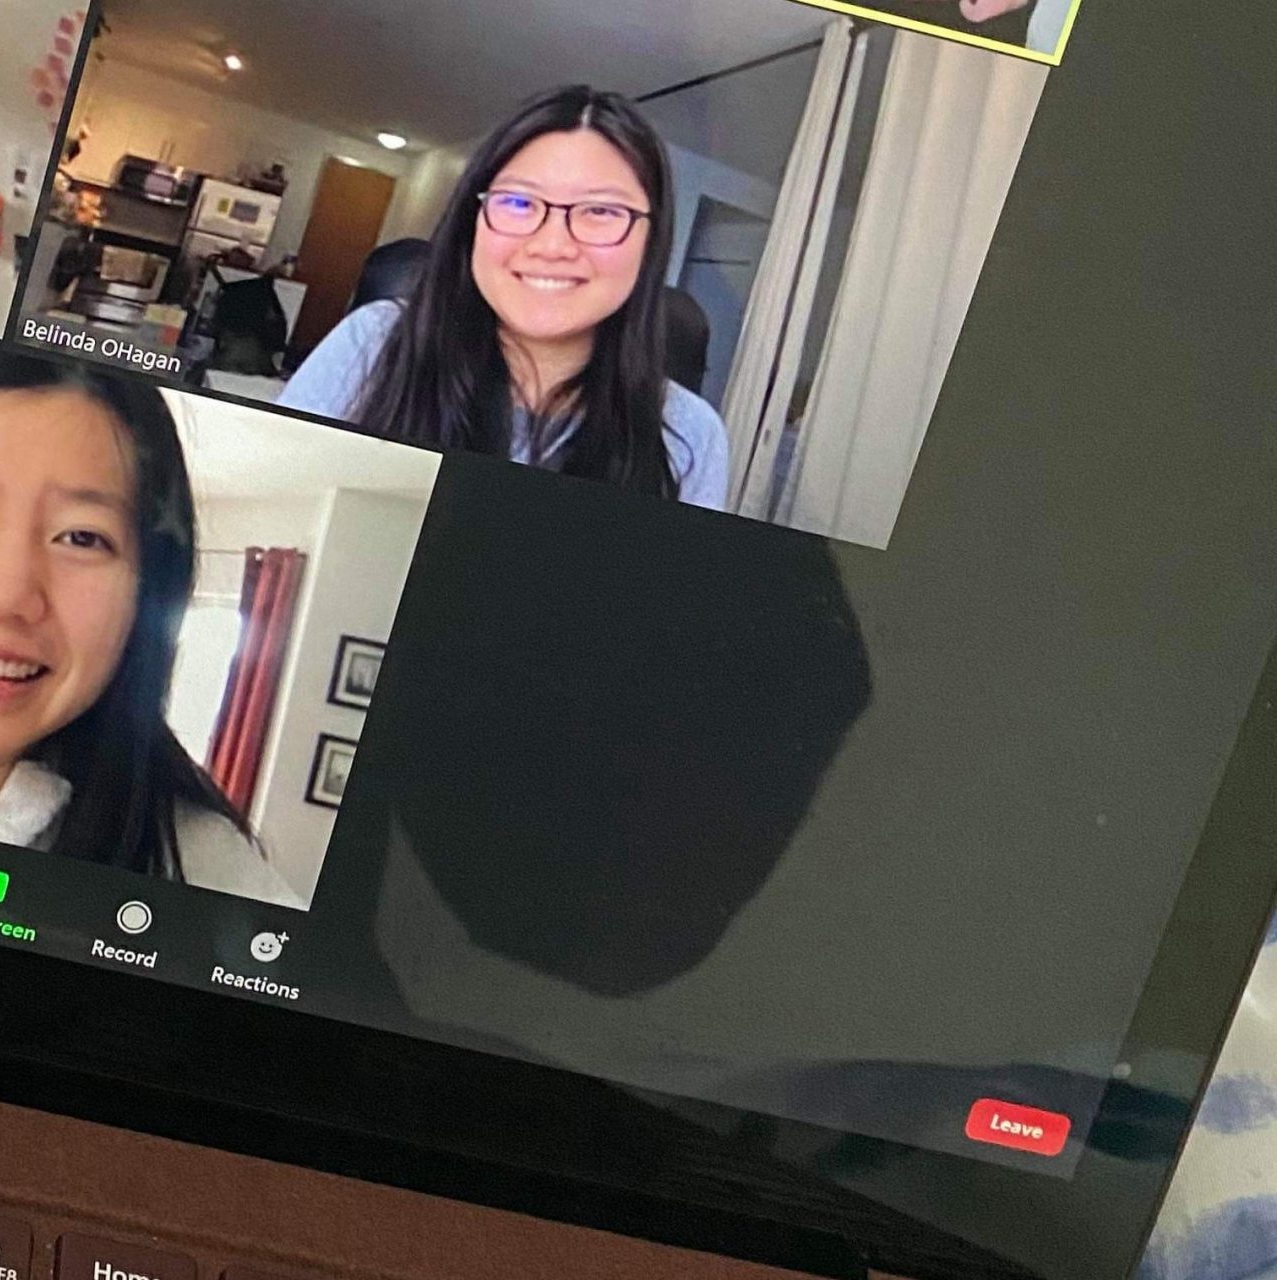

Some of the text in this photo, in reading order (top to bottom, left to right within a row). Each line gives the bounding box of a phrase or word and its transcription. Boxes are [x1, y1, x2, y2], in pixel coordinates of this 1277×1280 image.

[23, 320, 182, 372] Belinda OHagan
[92, 938, 158, 969] Record
[211, 965, 300, 1001] Reactions
[989, 1113, 1044, 1141] Leave
[93, 1261, 160, 1280] Ho
